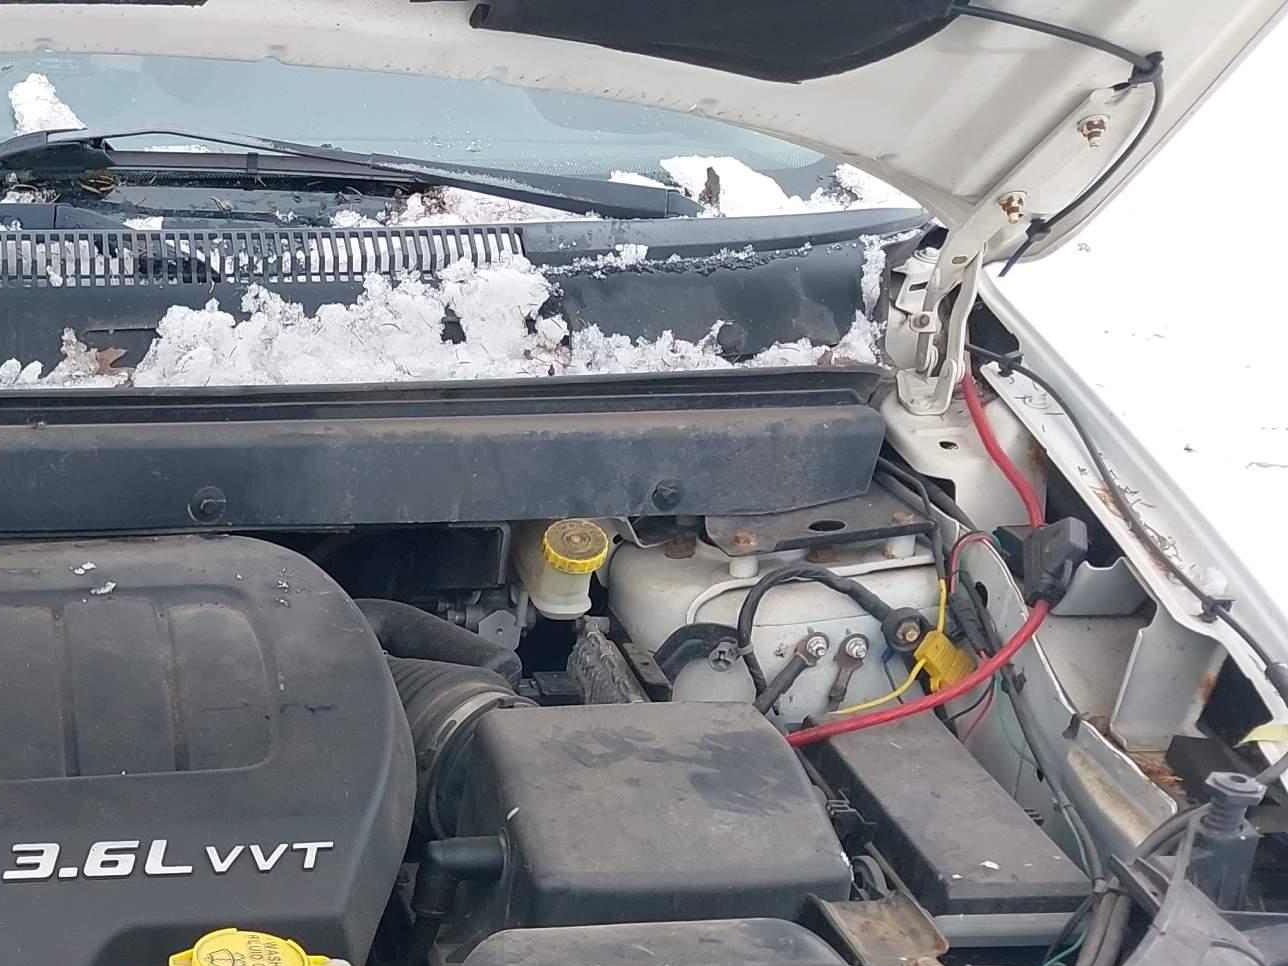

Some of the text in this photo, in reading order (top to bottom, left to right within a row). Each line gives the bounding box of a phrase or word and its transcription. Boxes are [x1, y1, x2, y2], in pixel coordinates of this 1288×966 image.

[2, 839, 334, 880] 3.6L VVT
[247, 934, 264, 961] FLUID
